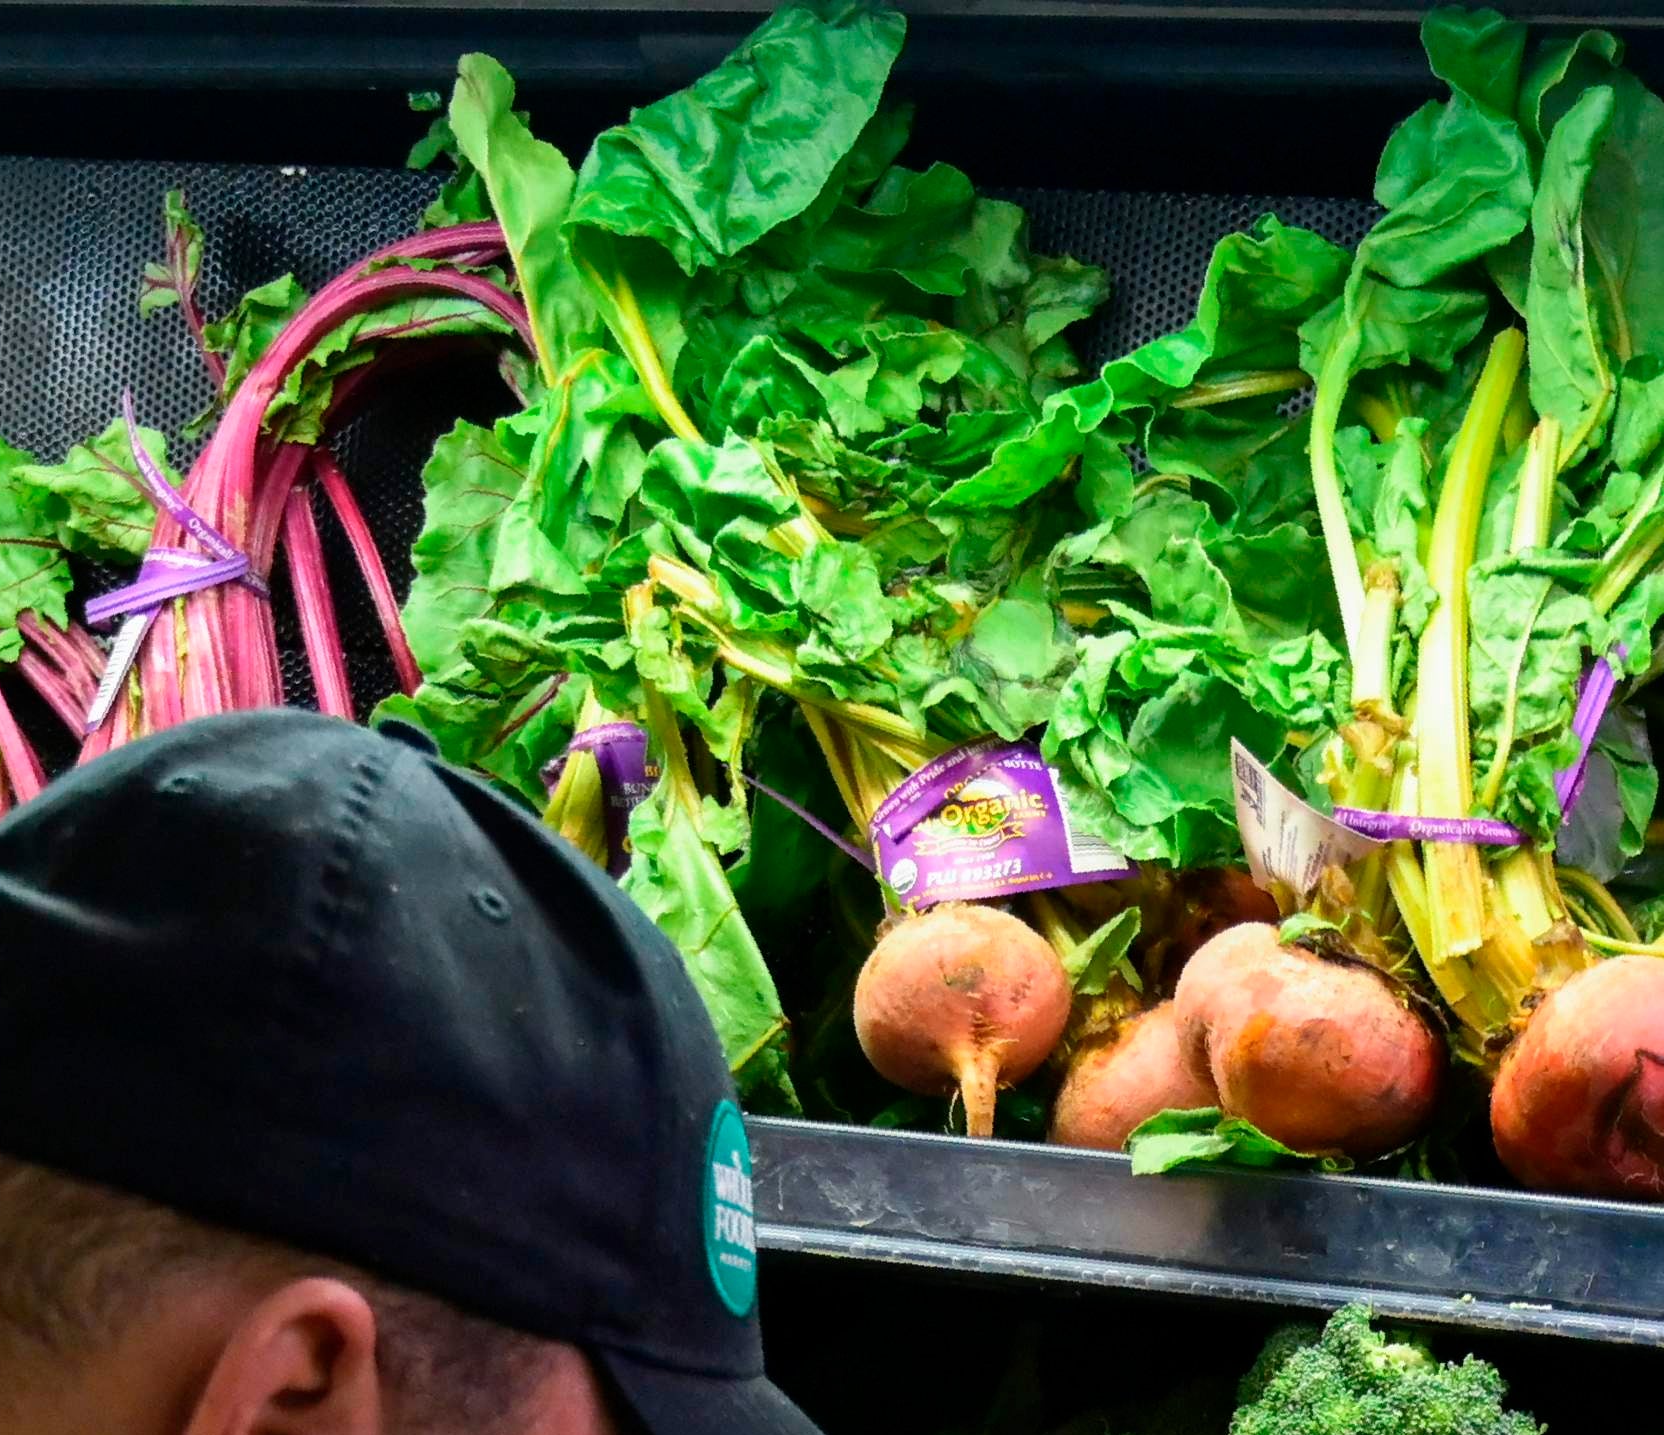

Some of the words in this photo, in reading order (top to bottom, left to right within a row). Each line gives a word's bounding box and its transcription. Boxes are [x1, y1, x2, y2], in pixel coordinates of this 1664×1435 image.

[188, 517, 236, 560] Organicall
[919, 762, 947, 788] Pride
[940, 788, 1044, 828] Organic
[1409, 820, 1476, 837] Organically
